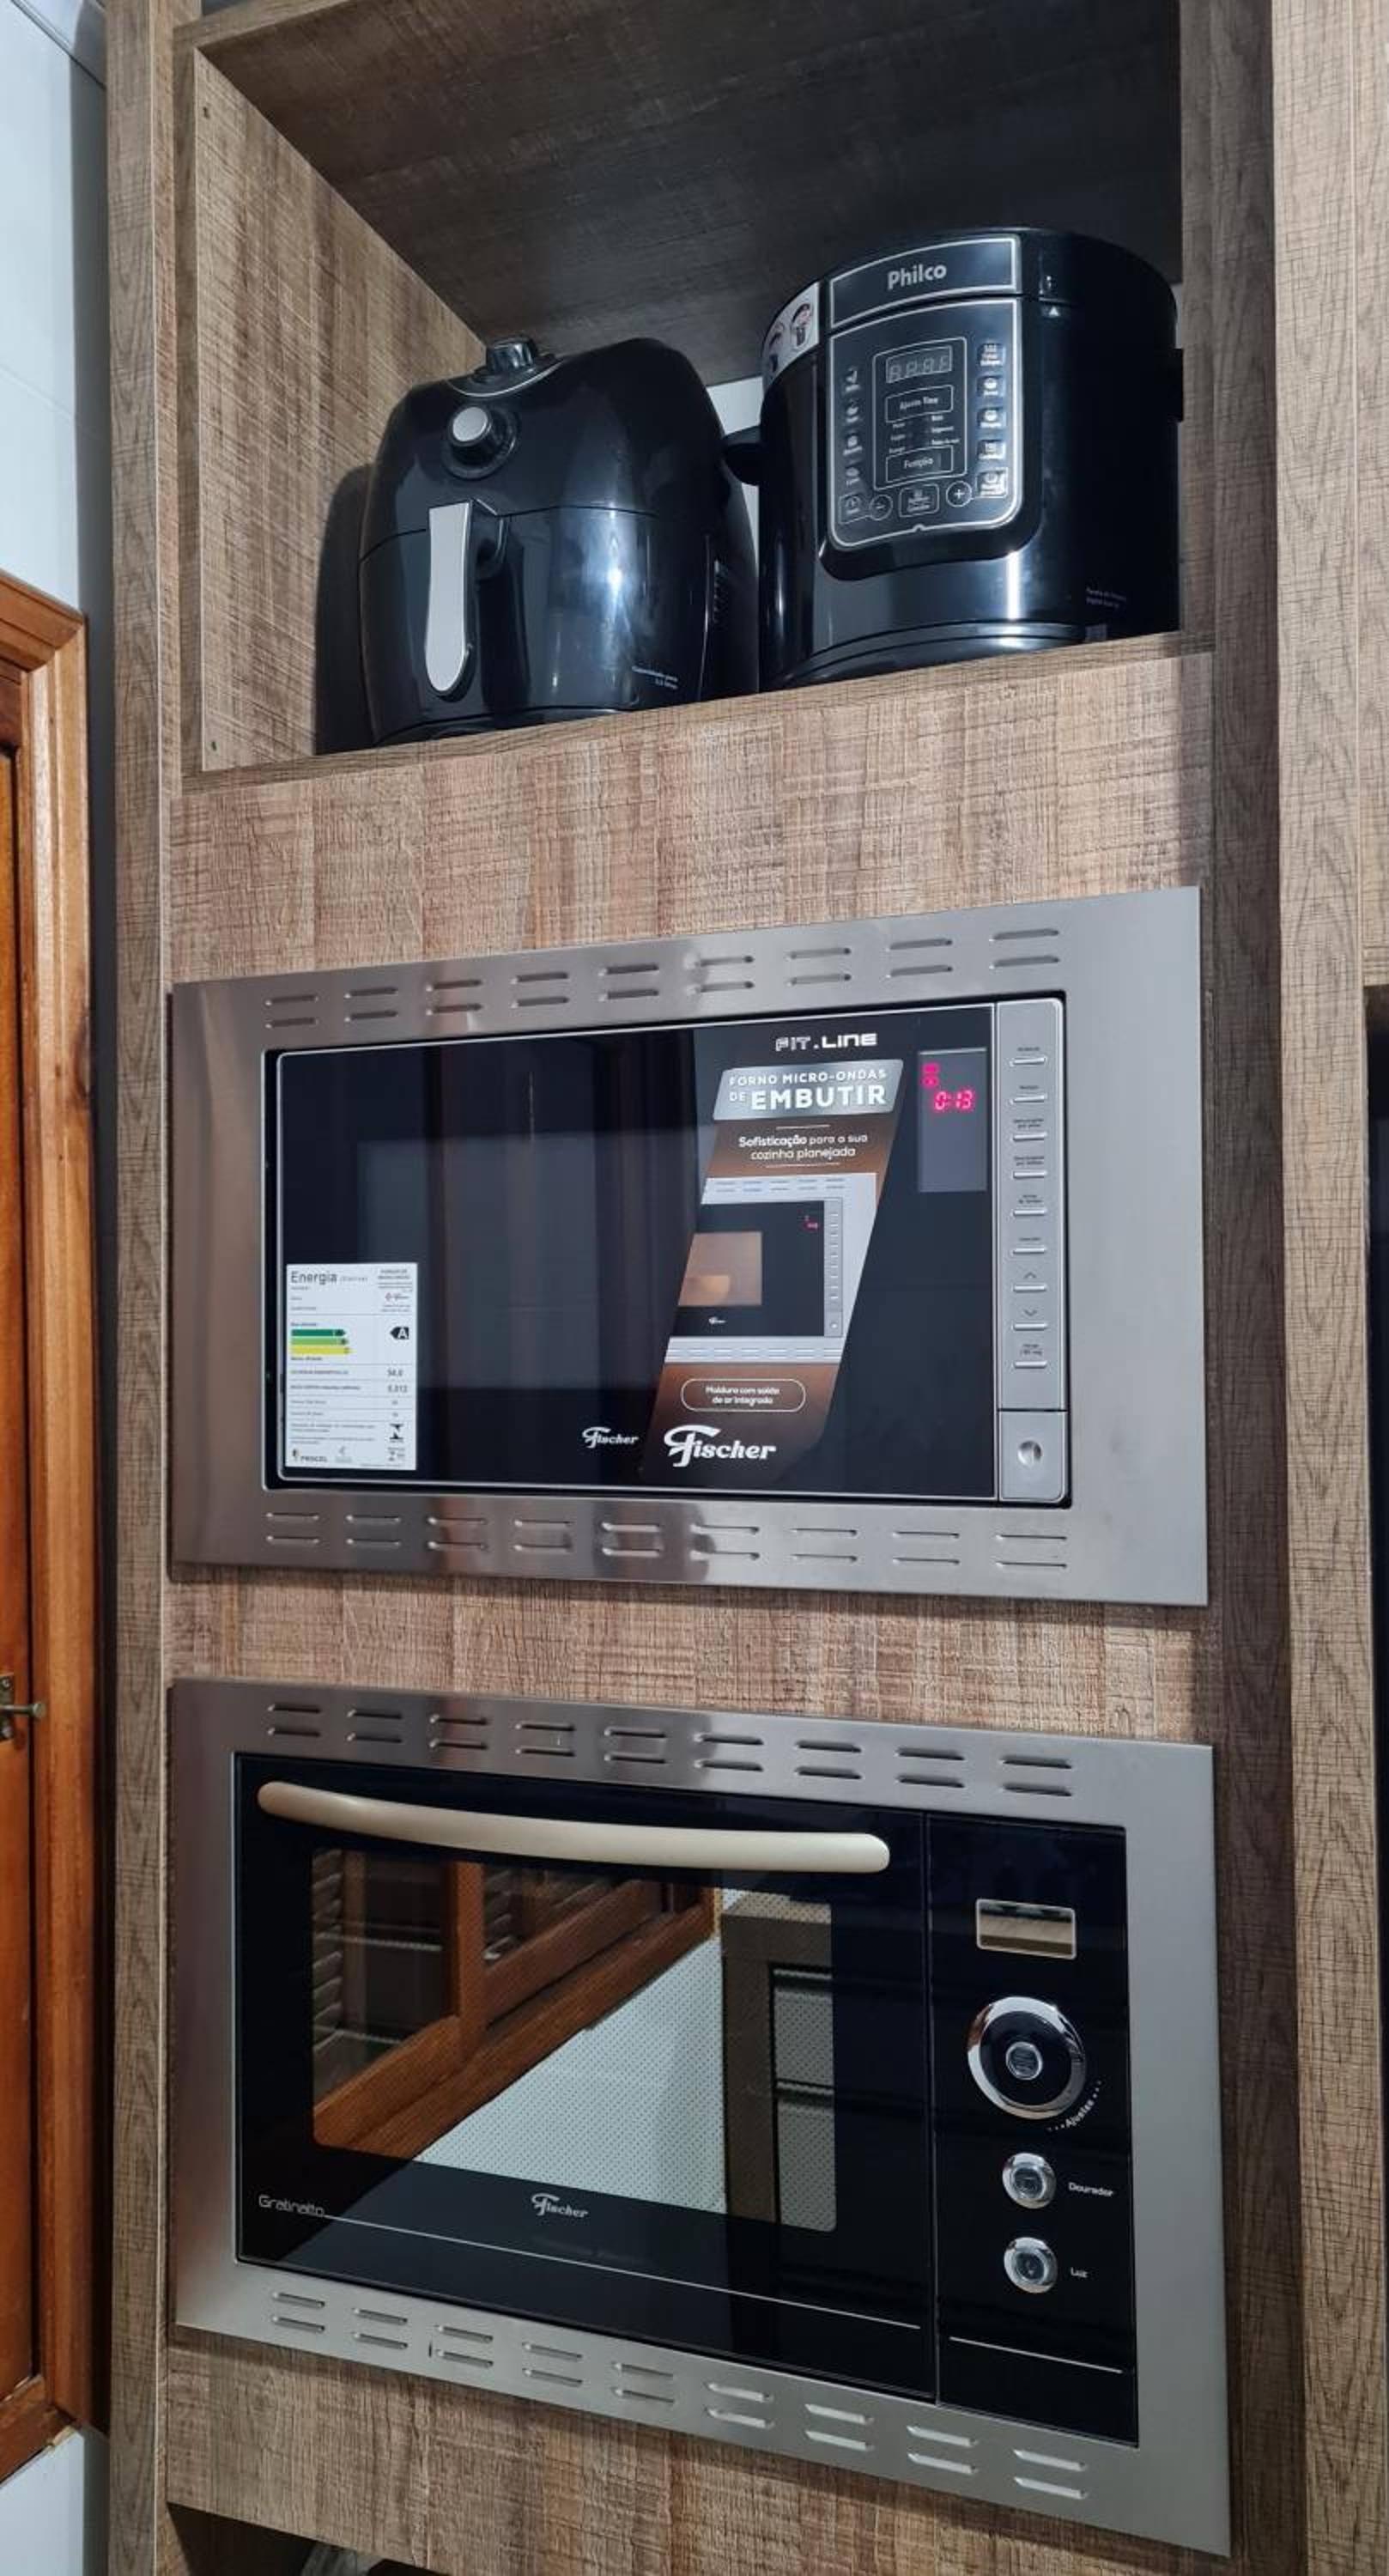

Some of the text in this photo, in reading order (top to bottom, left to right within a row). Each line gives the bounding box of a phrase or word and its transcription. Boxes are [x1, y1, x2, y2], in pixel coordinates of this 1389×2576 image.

[888, 264, 947, 290] Philco
[775, 1033, 877, 1051] FIT.LINE
[730, 1068, 887, 1087] FORNO MICRO-ONDAS
[730, 1084, 887, 1110] DE EMBUTIR
[738, 1134, 807, 1147] Sofisticação
[809, 1135, 834, 1145] para
[847, 1133, 868, 1143] sua
[750, 1146, 856, 1160] cozinha planejada
[290, 1270, 337, 1285] Energia
[582, 1426, 639, 1449] Fischer
[664, 1424, 777, 1467] Fischer
[1068, 2182, 1114, 2196] Dourador
[531, 2192, 589, 2218] Fischer
